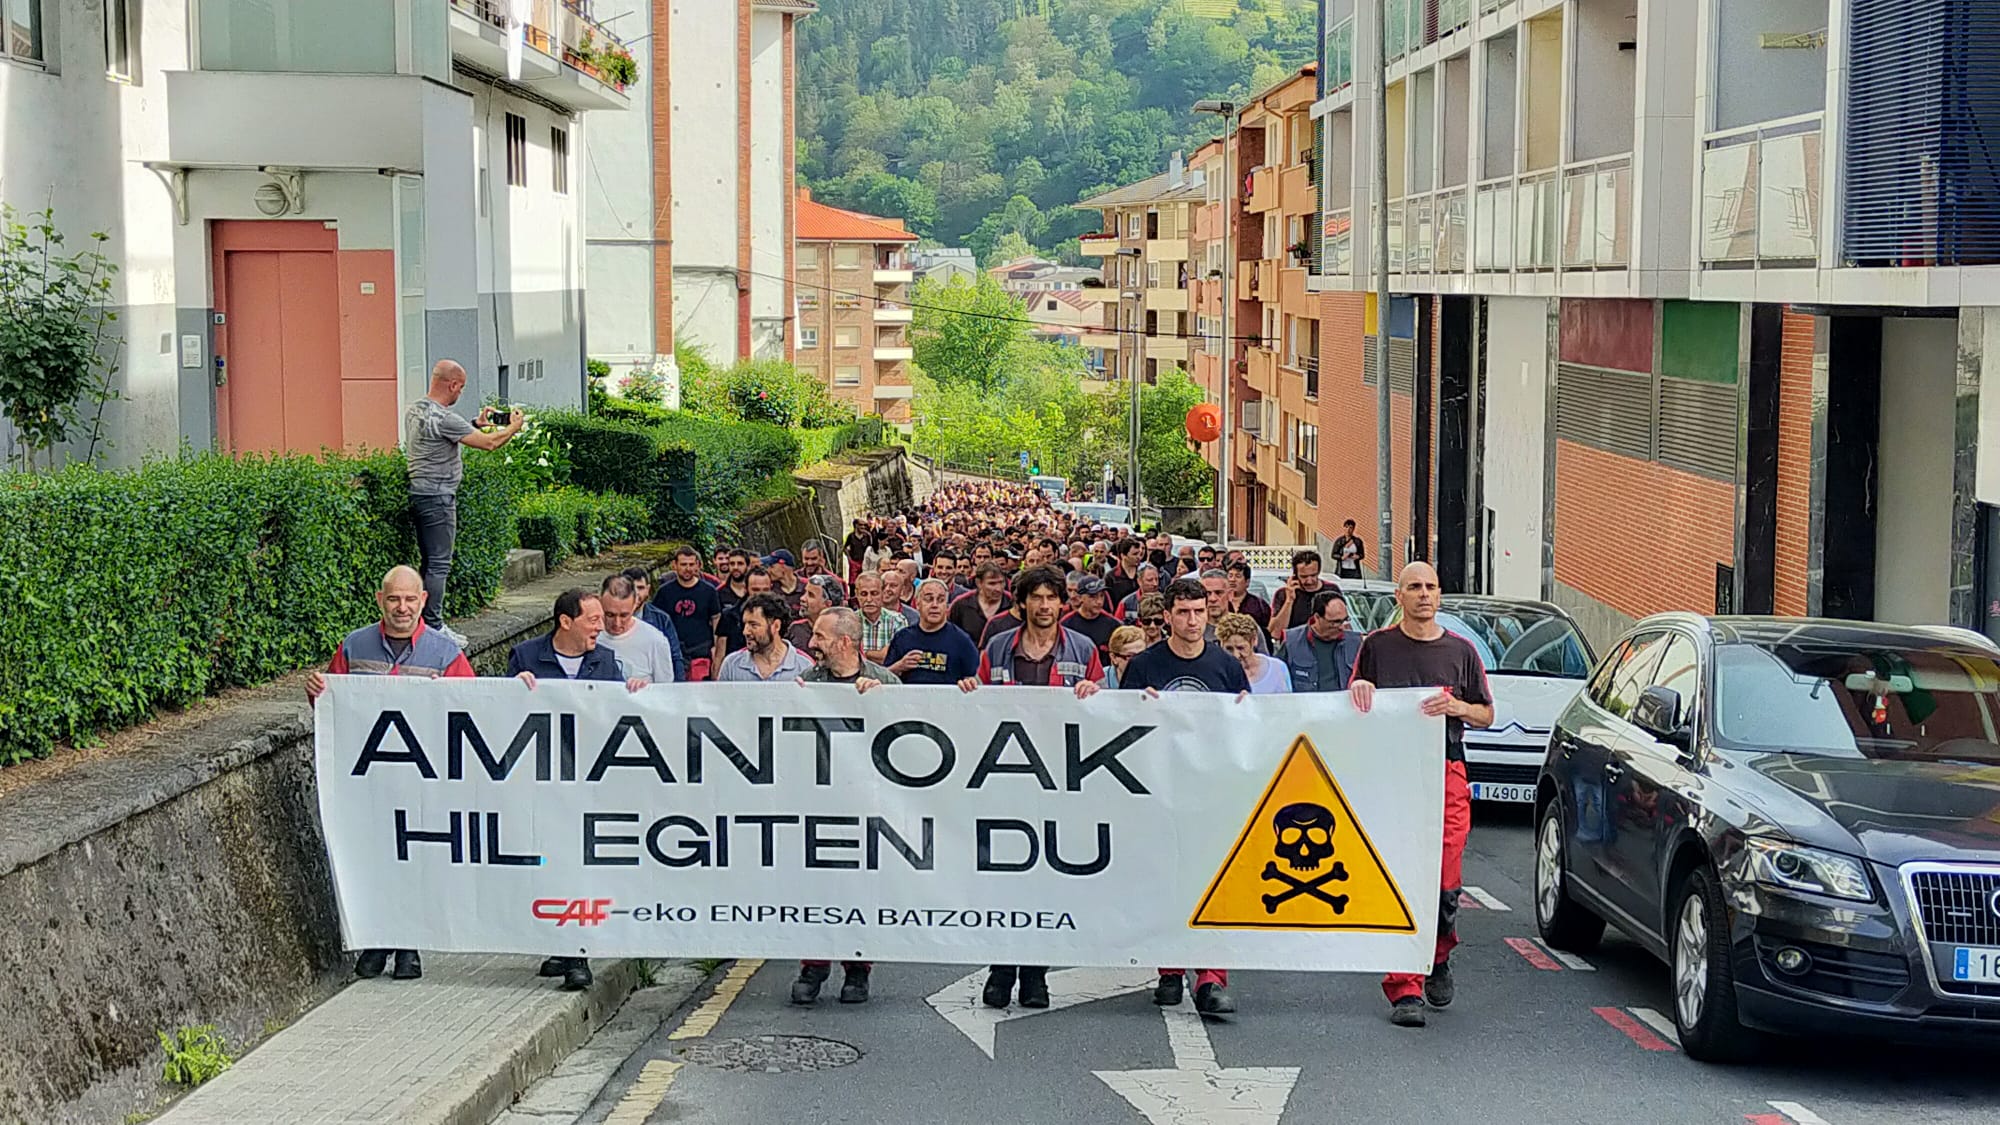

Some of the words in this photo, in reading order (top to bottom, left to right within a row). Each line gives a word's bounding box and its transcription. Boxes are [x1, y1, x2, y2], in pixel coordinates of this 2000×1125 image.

[350, 710, 1157, 795] AMIANTOAK
[1485, 786, 1518, 800] 1490
[394, 809, 542, 866] HIL
[583, 812, 934, 871] EGITEN
[975, 818, 1111, 876] DU
[710, 904, 867, 926] ENPRESA
[878, 908, 1077, 931] BATZORDEA
